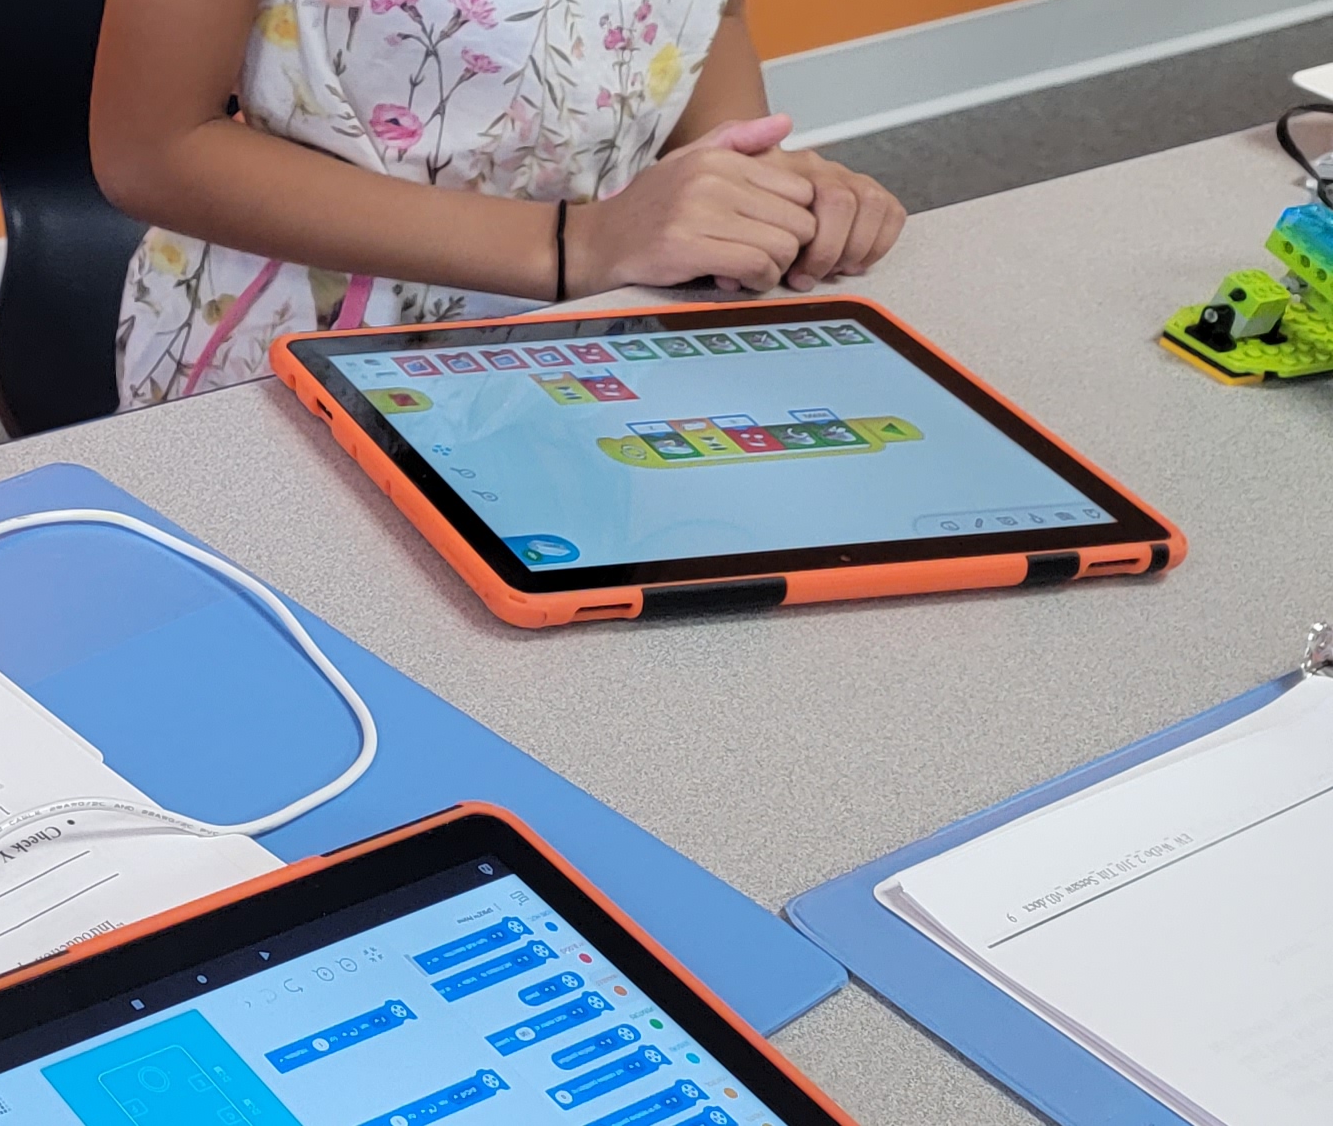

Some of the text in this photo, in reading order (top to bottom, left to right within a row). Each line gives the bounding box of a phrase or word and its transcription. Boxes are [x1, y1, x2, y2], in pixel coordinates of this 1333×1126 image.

[113, 802, 136, 812] AND
[11, 827, 61, 852] Check
[1006, 913, 1018, 923] 9
